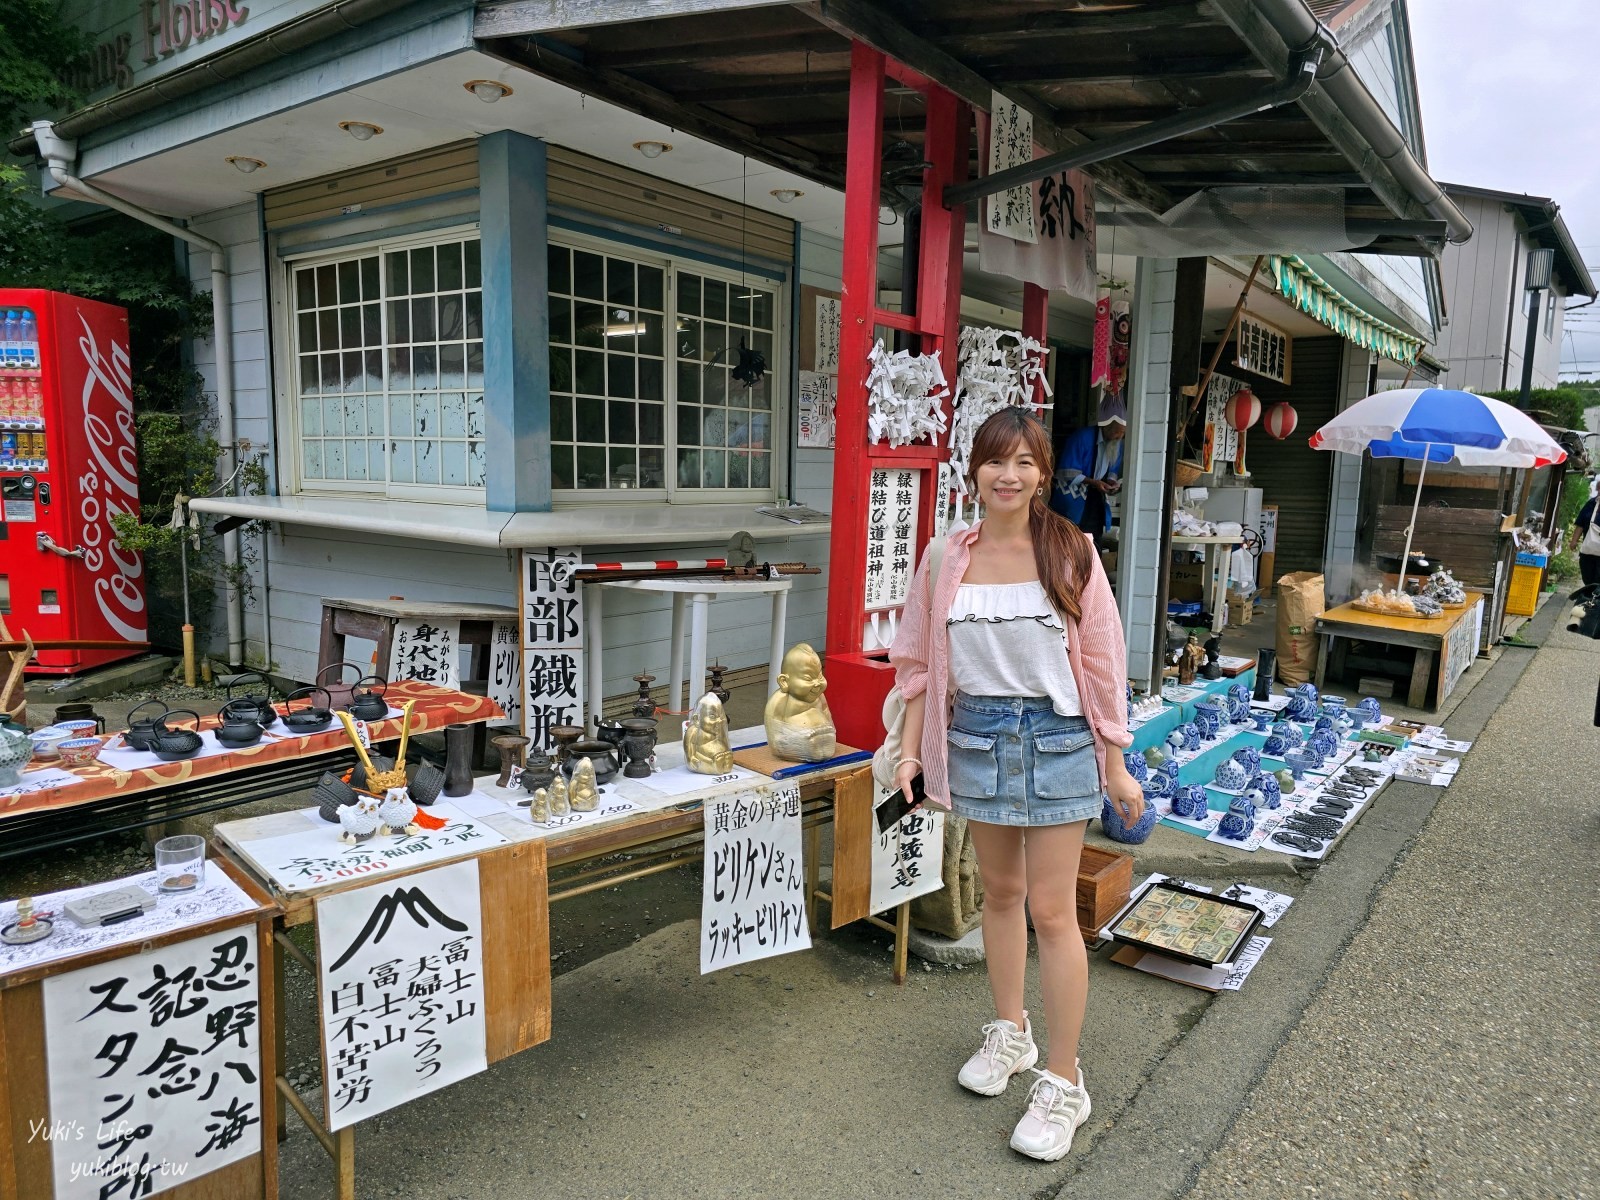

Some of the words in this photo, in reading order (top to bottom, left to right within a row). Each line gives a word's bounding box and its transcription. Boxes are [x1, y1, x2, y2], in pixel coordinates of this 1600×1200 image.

[77, 307, 147, 642] Coca-Cola
[867, 471, 889, 577] 縁結び道祖神
[891, 472, 914, 575] 縁結び道祖神
[440, 630, 450, 685] みがわり
[495, 650, 521, 689] ビリ
[713, 788, 800, 837] 黄金の幸運
[713, 838, 801, 905] ビリケンさん
[708, 901, 803, 963] ラッキービリケン
[137, 963, 209, 1099] 記念
[195, 935, 261, 1158] 忍野八海
[407, 955, 443, 1081] 夫婦ふくろう
